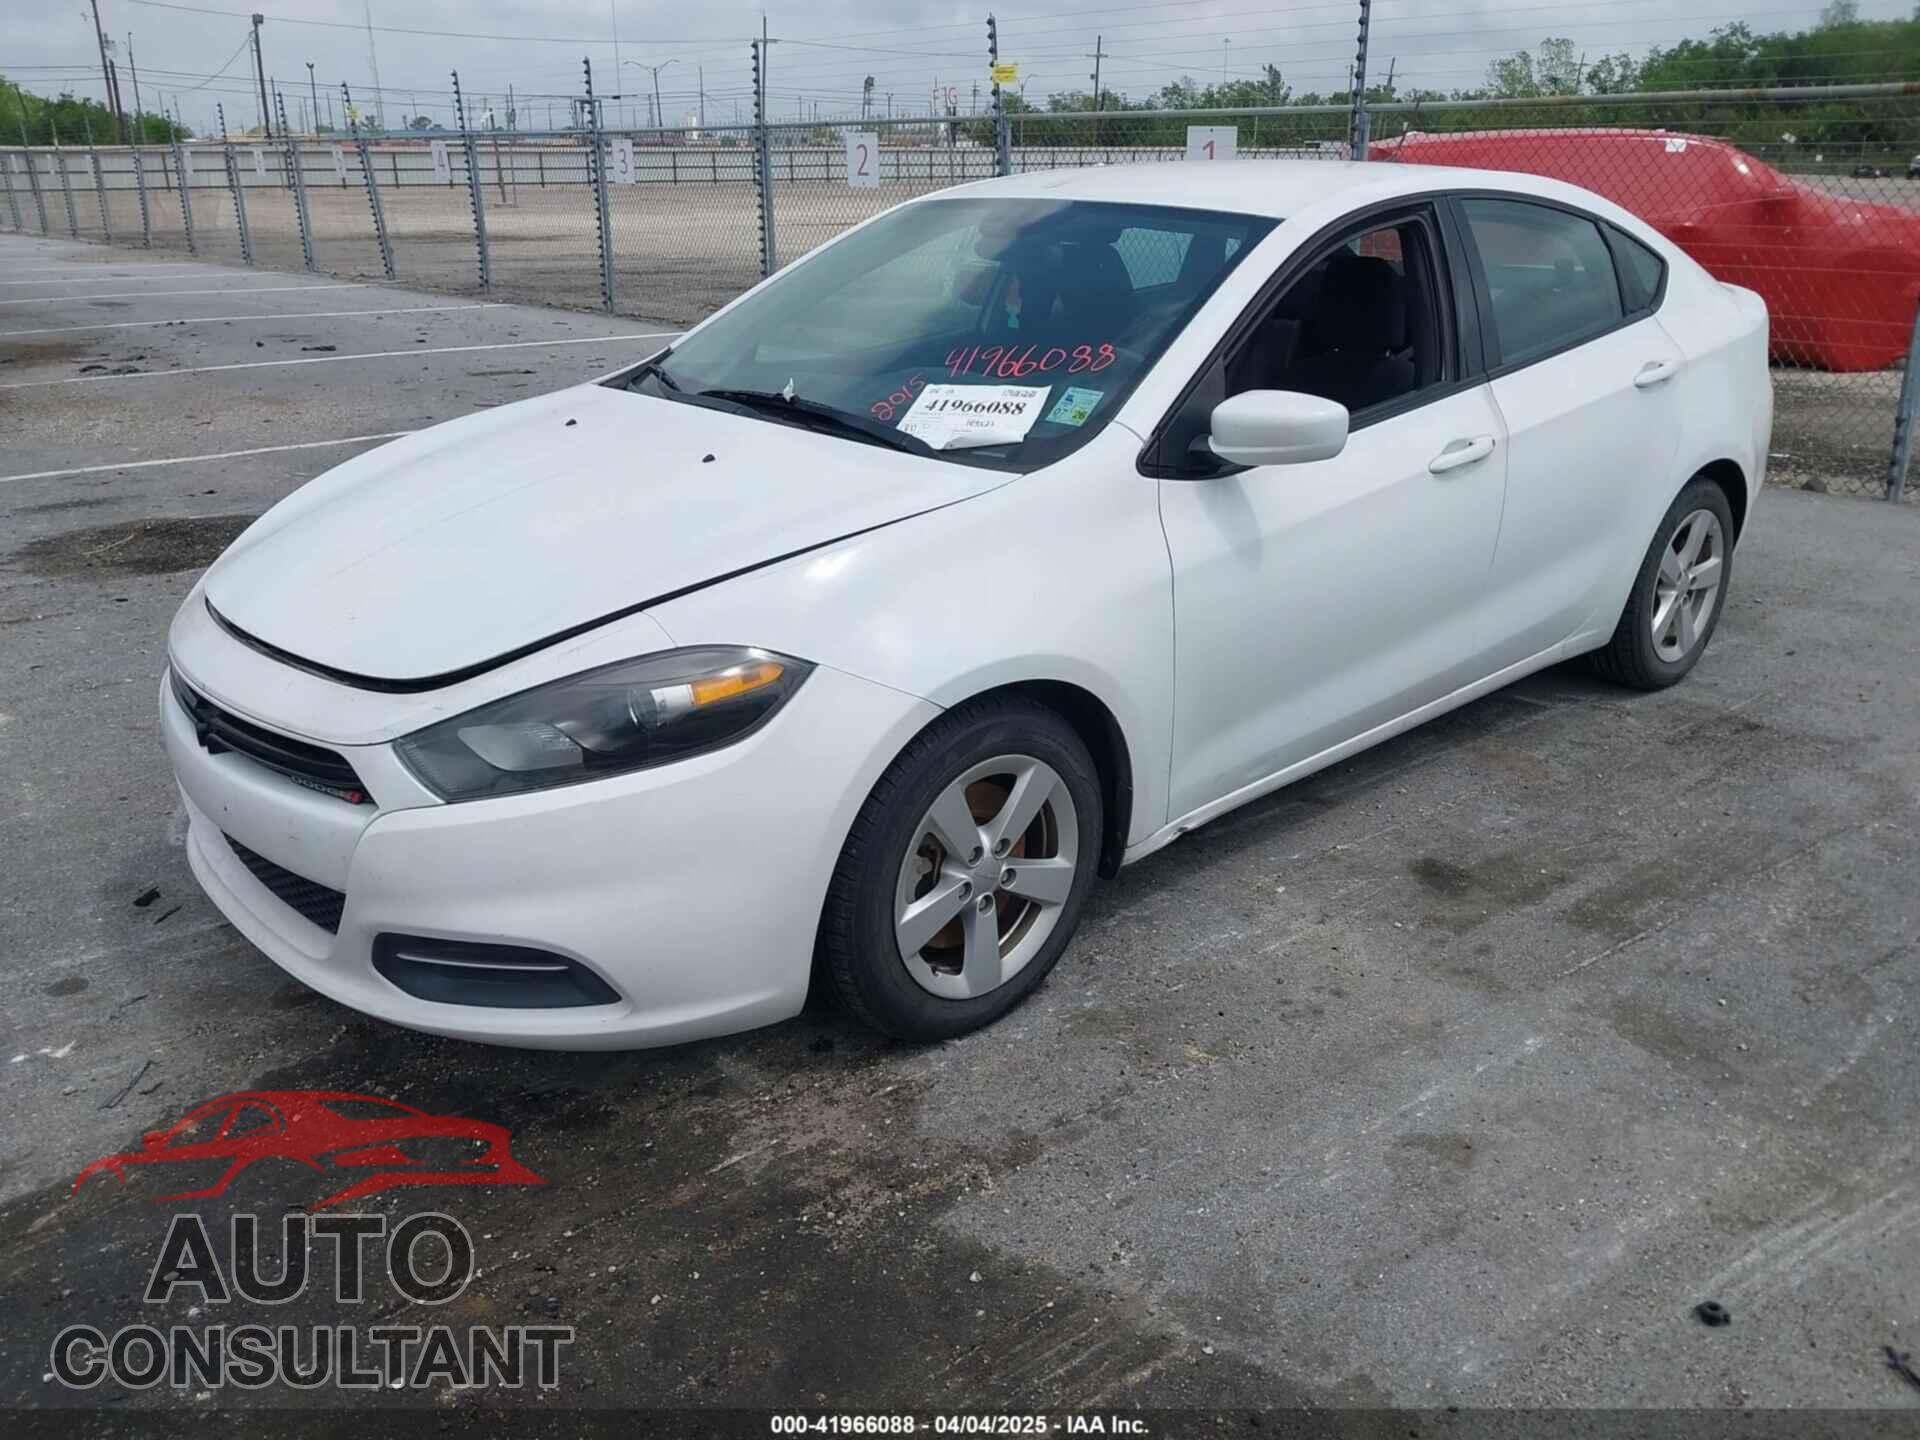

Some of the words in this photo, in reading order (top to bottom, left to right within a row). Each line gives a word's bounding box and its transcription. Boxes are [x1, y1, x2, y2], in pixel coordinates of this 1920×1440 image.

[618, 148, 628, 175] 3
[856, 143, 870, 177] 2
[1202, 139, 1215, 161] 1
[945, 343, 1116, 378] 41966088
[871, 372, 927, 422] 2015
[925, 399, 1027, 415] 41966088
